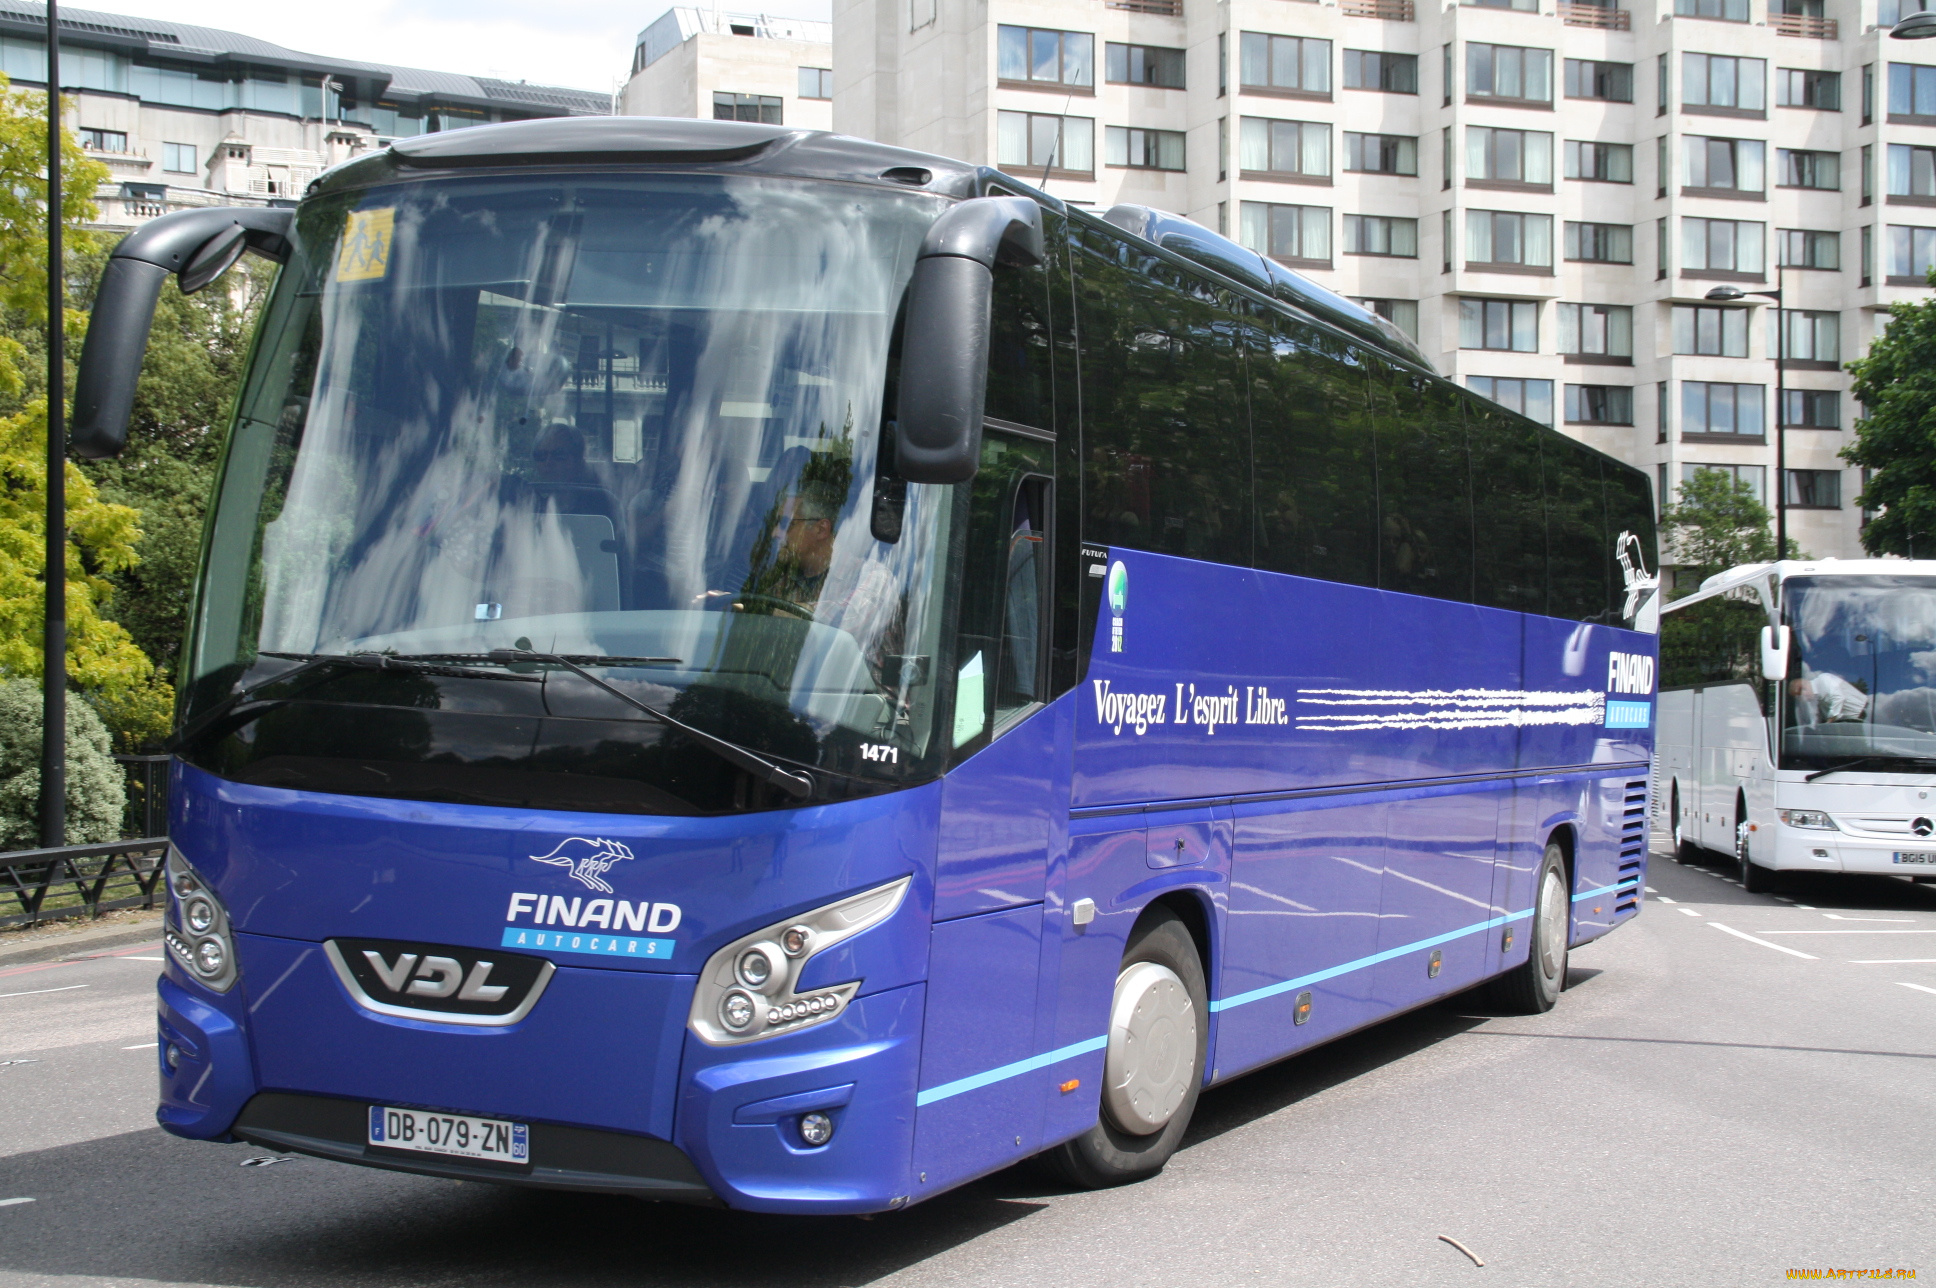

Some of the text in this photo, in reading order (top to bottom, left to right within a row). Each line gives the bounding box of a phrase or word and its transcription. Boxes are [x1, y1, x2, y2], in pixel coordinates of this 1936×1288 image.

[1607, 651, 1654, 695] FINAND
[1093, 680, 1289, 735] Voyagez L'esprit Libre.
[860, 743, 898, 764] 1471
[506, 892, 682, 933] FINAND
[517, 932, 657, 954] AUTOCARS
[362, 950, 510, 1002] VDL
[374, 1127, 380, 1136] F
[388, 1111, 510, 1154] DB-079-ZN
[513, 1142, 526, 1157] 60
